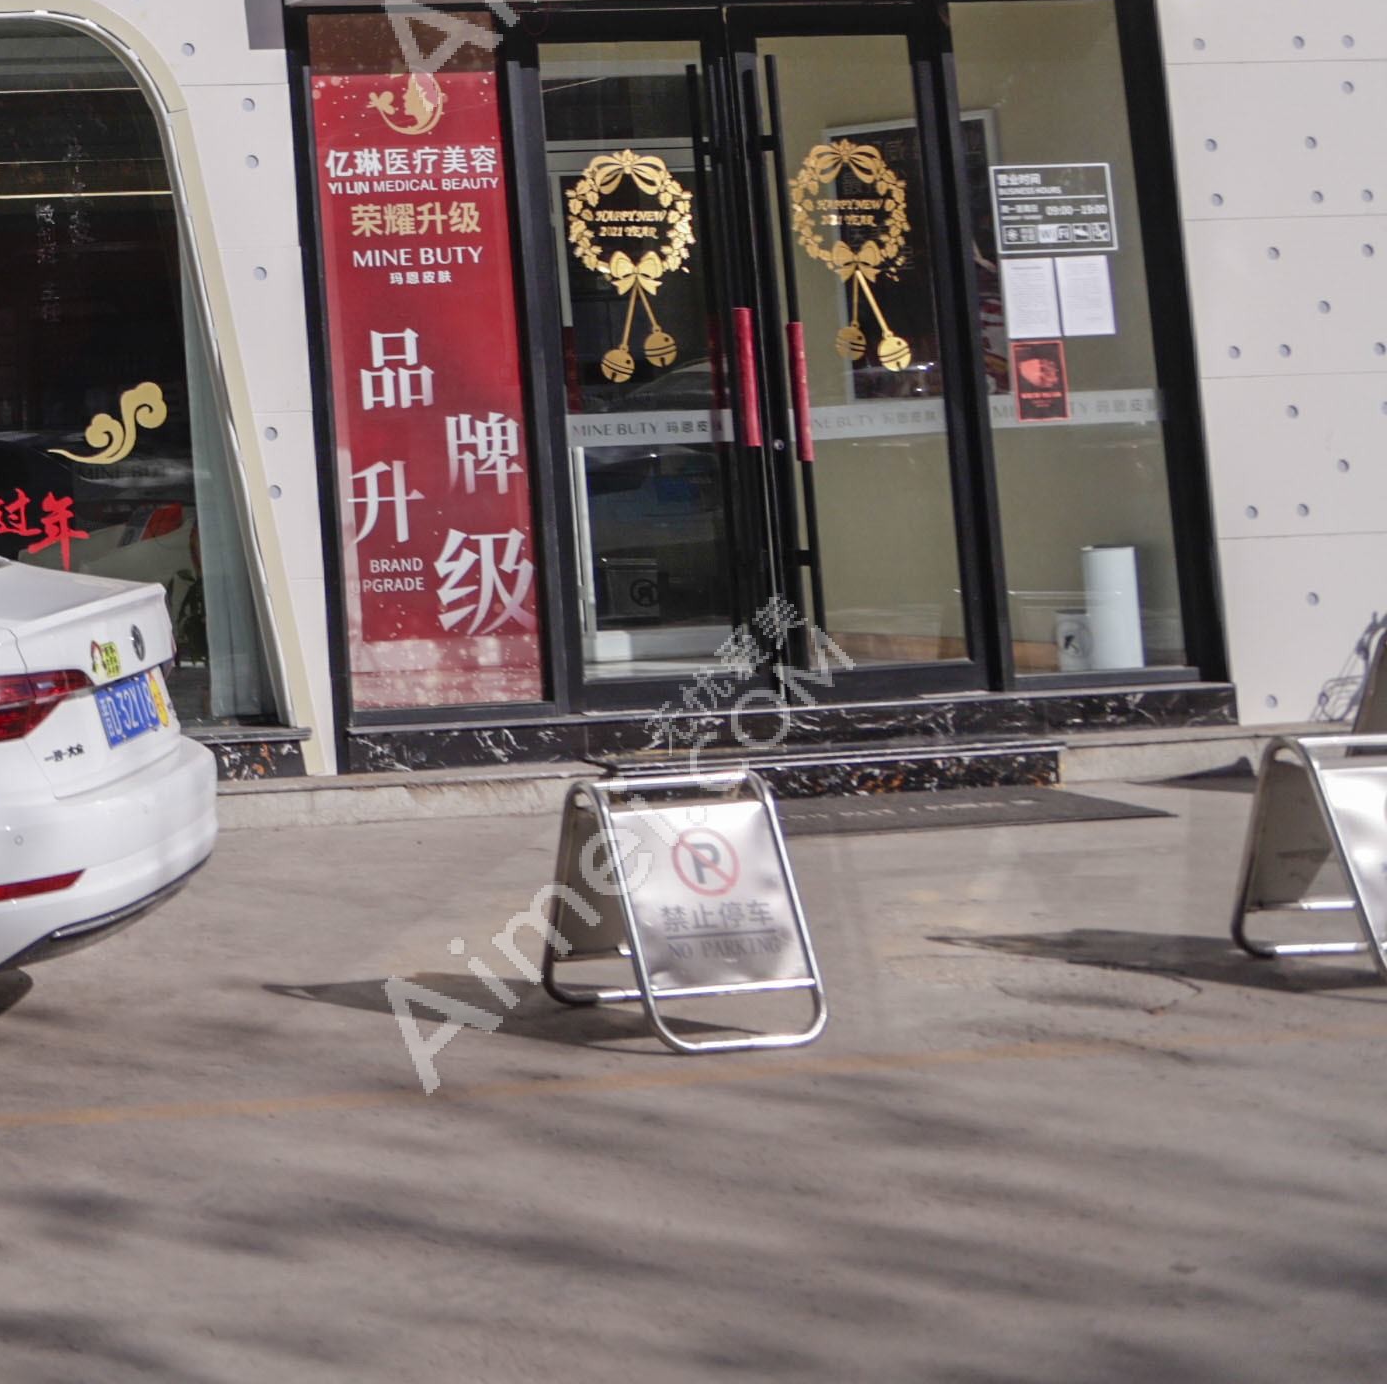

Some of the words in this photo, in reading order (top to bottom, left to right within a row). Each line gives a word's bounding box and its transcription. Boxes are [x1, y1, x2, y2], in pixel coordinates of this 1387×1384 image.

[325, 145, 498, 178] 亿琳医疗美容
[328, 182, 343, 195] YI
[374, 179, 438, 193] MEDICAL
[442, 177, 499, 191] BEAUTY
[351, 201, 481, 237] 荣耀升级
[353, 248, 413, 267] MINE
[420, 246, 483, 266] BUTY
[390, 270, 452, 285] 玛恩皮肤
[572, 422, 613, 436] MINE
[617, 420, 658, 435] BUTY
[370, 557, 423, 573] BRAND
[661, 900, 774, 933] 禁止停车
[667, 942, 693, 960] NO
[701, 934, 783, 959] PARKING
